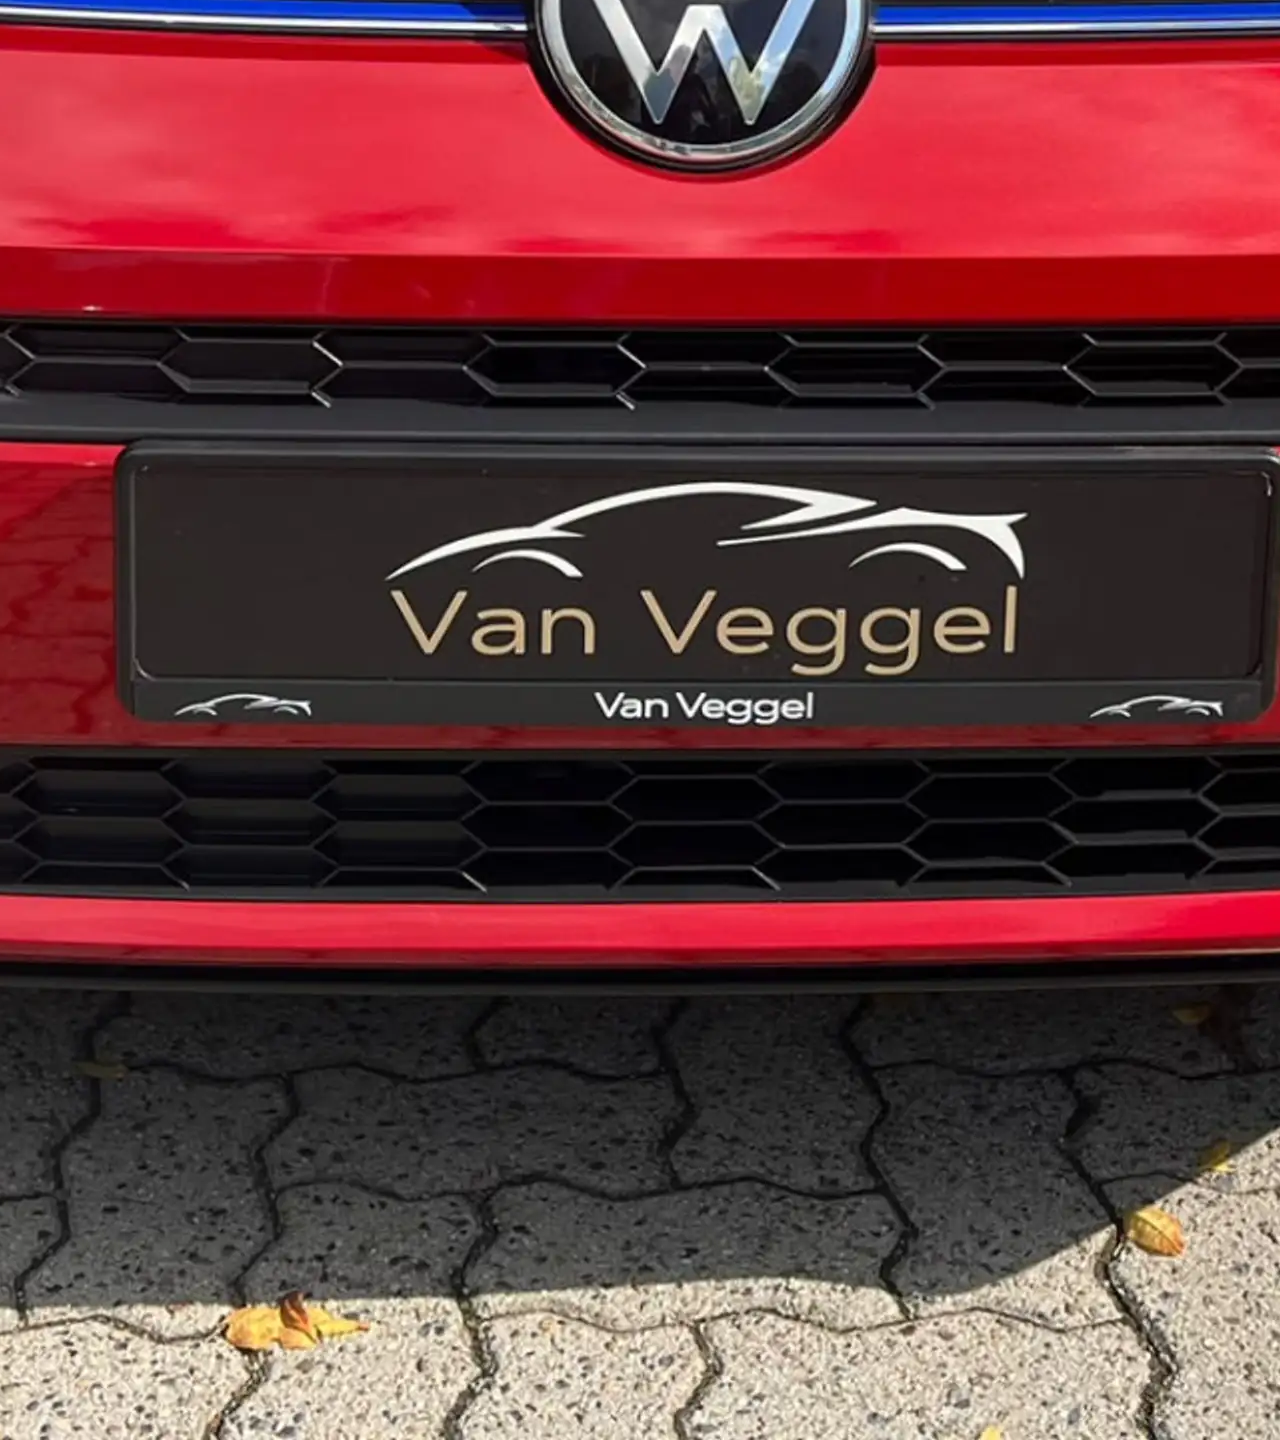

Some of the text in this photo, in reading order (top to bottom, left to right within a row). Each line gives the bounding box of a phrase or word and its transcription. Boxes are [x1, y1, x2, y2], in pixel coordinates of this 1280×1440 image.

[390, 585, 1019, 677] Van Veggel
[593, 691, 815, 726] Van Veggel
